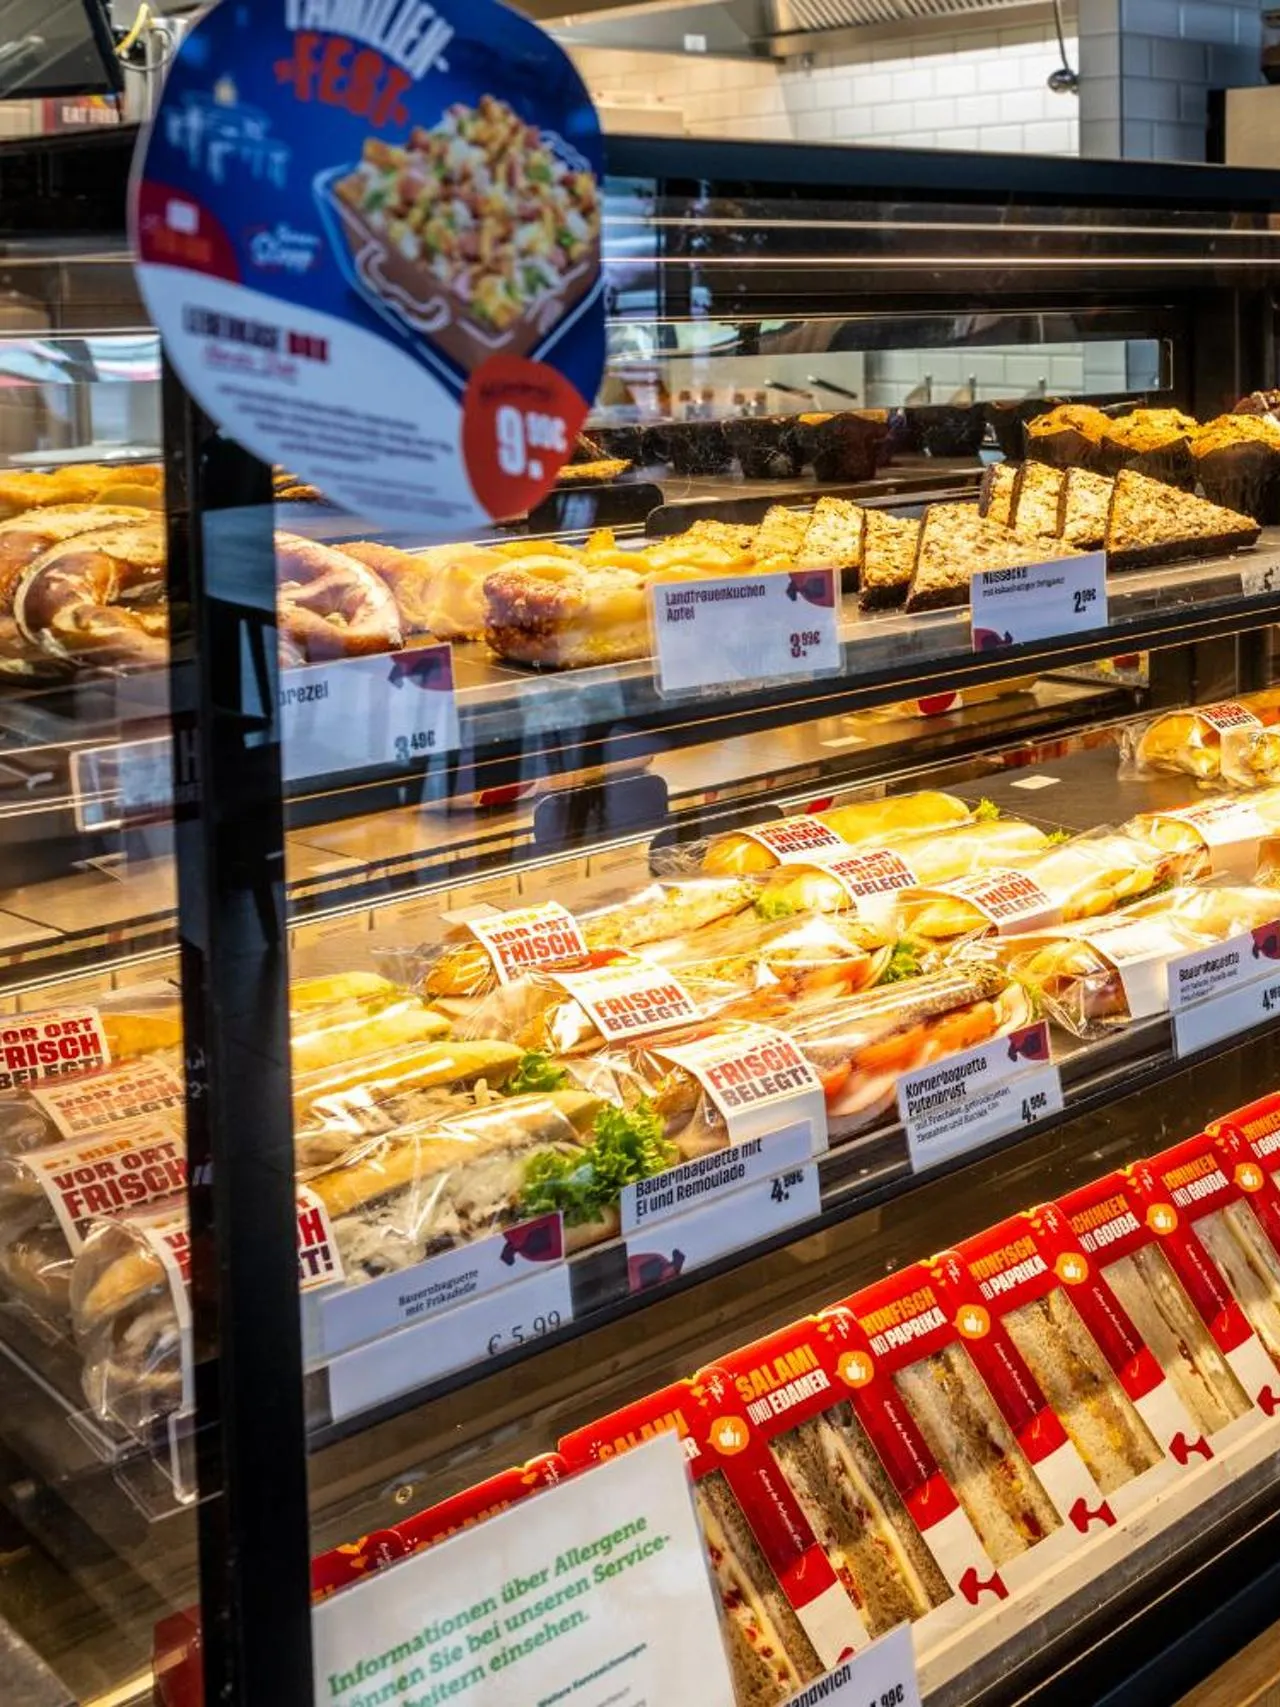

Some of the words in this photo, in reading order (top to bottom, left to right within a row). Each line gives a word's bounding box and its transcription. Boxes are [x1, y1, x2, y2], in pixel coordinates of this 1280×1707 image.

[665, 583, 766, 606] Landfrauenkuchen
[667, 605, 695, 622] Apfel
[850, 872, 918, 898] BELEGT!
[494, 931, 583, 967] FRISCH
[592, 985, 685, 1020] FRISCH
[603, 1000, 695, 1034] BELEGT!
[44, 1017, 94, 1038] ORT
[704, 1043, 802, 1090] FRISCH
[718, 1064, 814, 1108] BELEGT!
[907, 1081, 968, 1117] Putenbrust
[53, 1161, 118, 1191] VOR
[121, 1142, 178, 1170] ORT
[61, 1157, 188, 1220] FRISCH
[635, 1145, 740, 1198] Bauernbaguette
[741, 1138, 764, 1159] mit
[1187, 1169, 1230, 1202] GOUDA
[636, 1199, 648, 1218] Ei
[650, 1190, 675, 1213] und
[676, 1163, 746, 1203] Remoulade
[1093, 1210, 1142, 1248] GOUDA
[988, 1254, 1050, 1297] PAPRIKA
[885, 1306, 948, 1351] PAPRIKA
[734, 1343, 820, 1403] SALAMI
[746, 1397, 774, 1427] UND
[767, 1368, 832, 1416] EDAMER
[326, 1593, 499, 1698] Informationen
[501, 1566, 550, 1604] über
[553, 1515, 649, 1579] Allergene
[428, 1645, 465, 1675] Sie
[467, 1622, 502, 1654] bei
[504, 1577, 591, 1634] unseren
[591, 1533, 672, 1585] Service-
[488, 1605, 592, 1673] einsehen.
